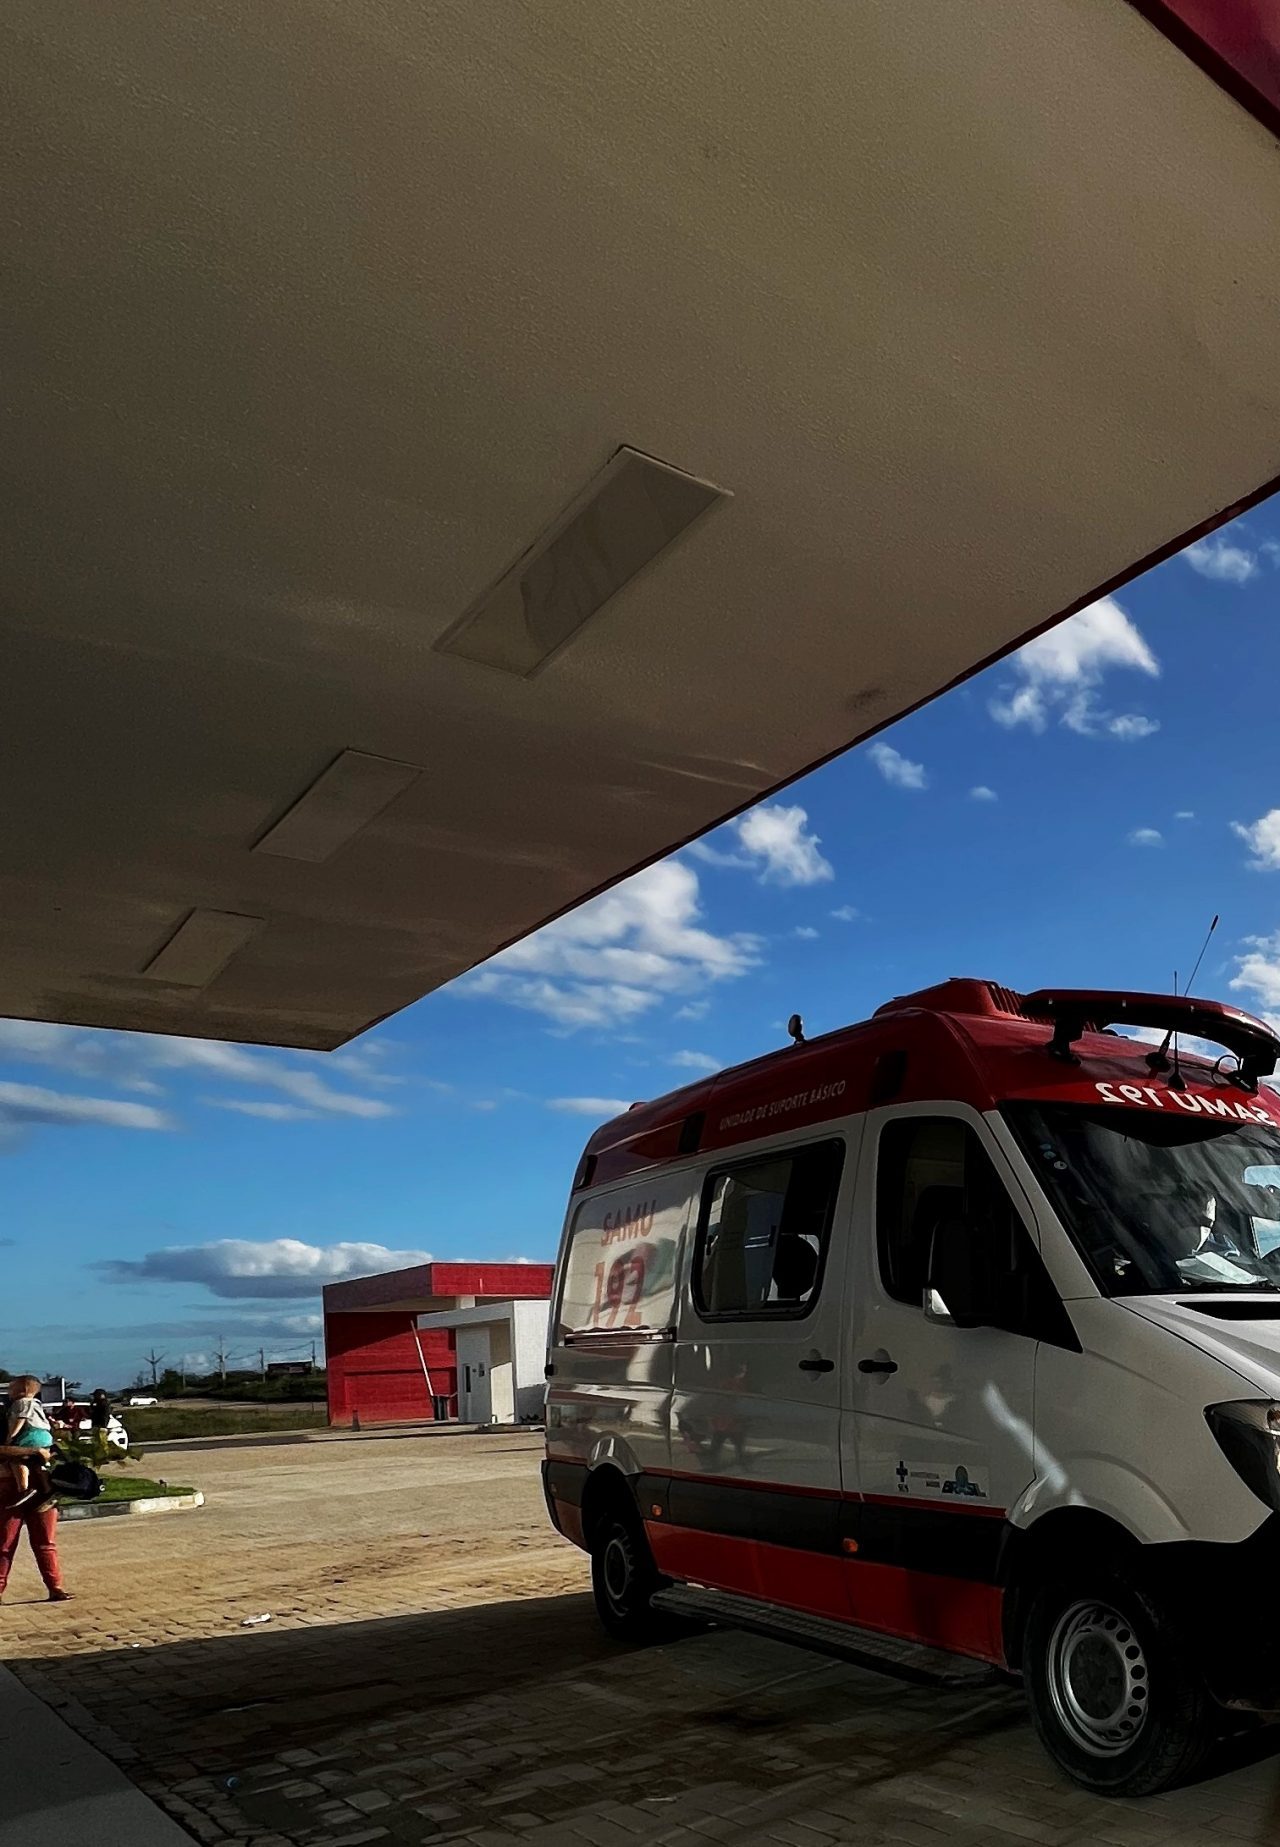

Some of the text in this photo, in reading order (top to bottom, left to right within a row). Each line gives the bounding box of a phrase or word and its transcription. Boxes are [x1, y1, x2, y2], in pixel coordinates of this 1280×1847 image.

[719, 1108, 756, 1131] UNIDADE
[756, 1104, 769, 1120] DE
[769, 1091, 809, 1116] SUPORTE
[601, 1200, 657, 1247] SAMU
[593, 1255, 645, 1327] 192
